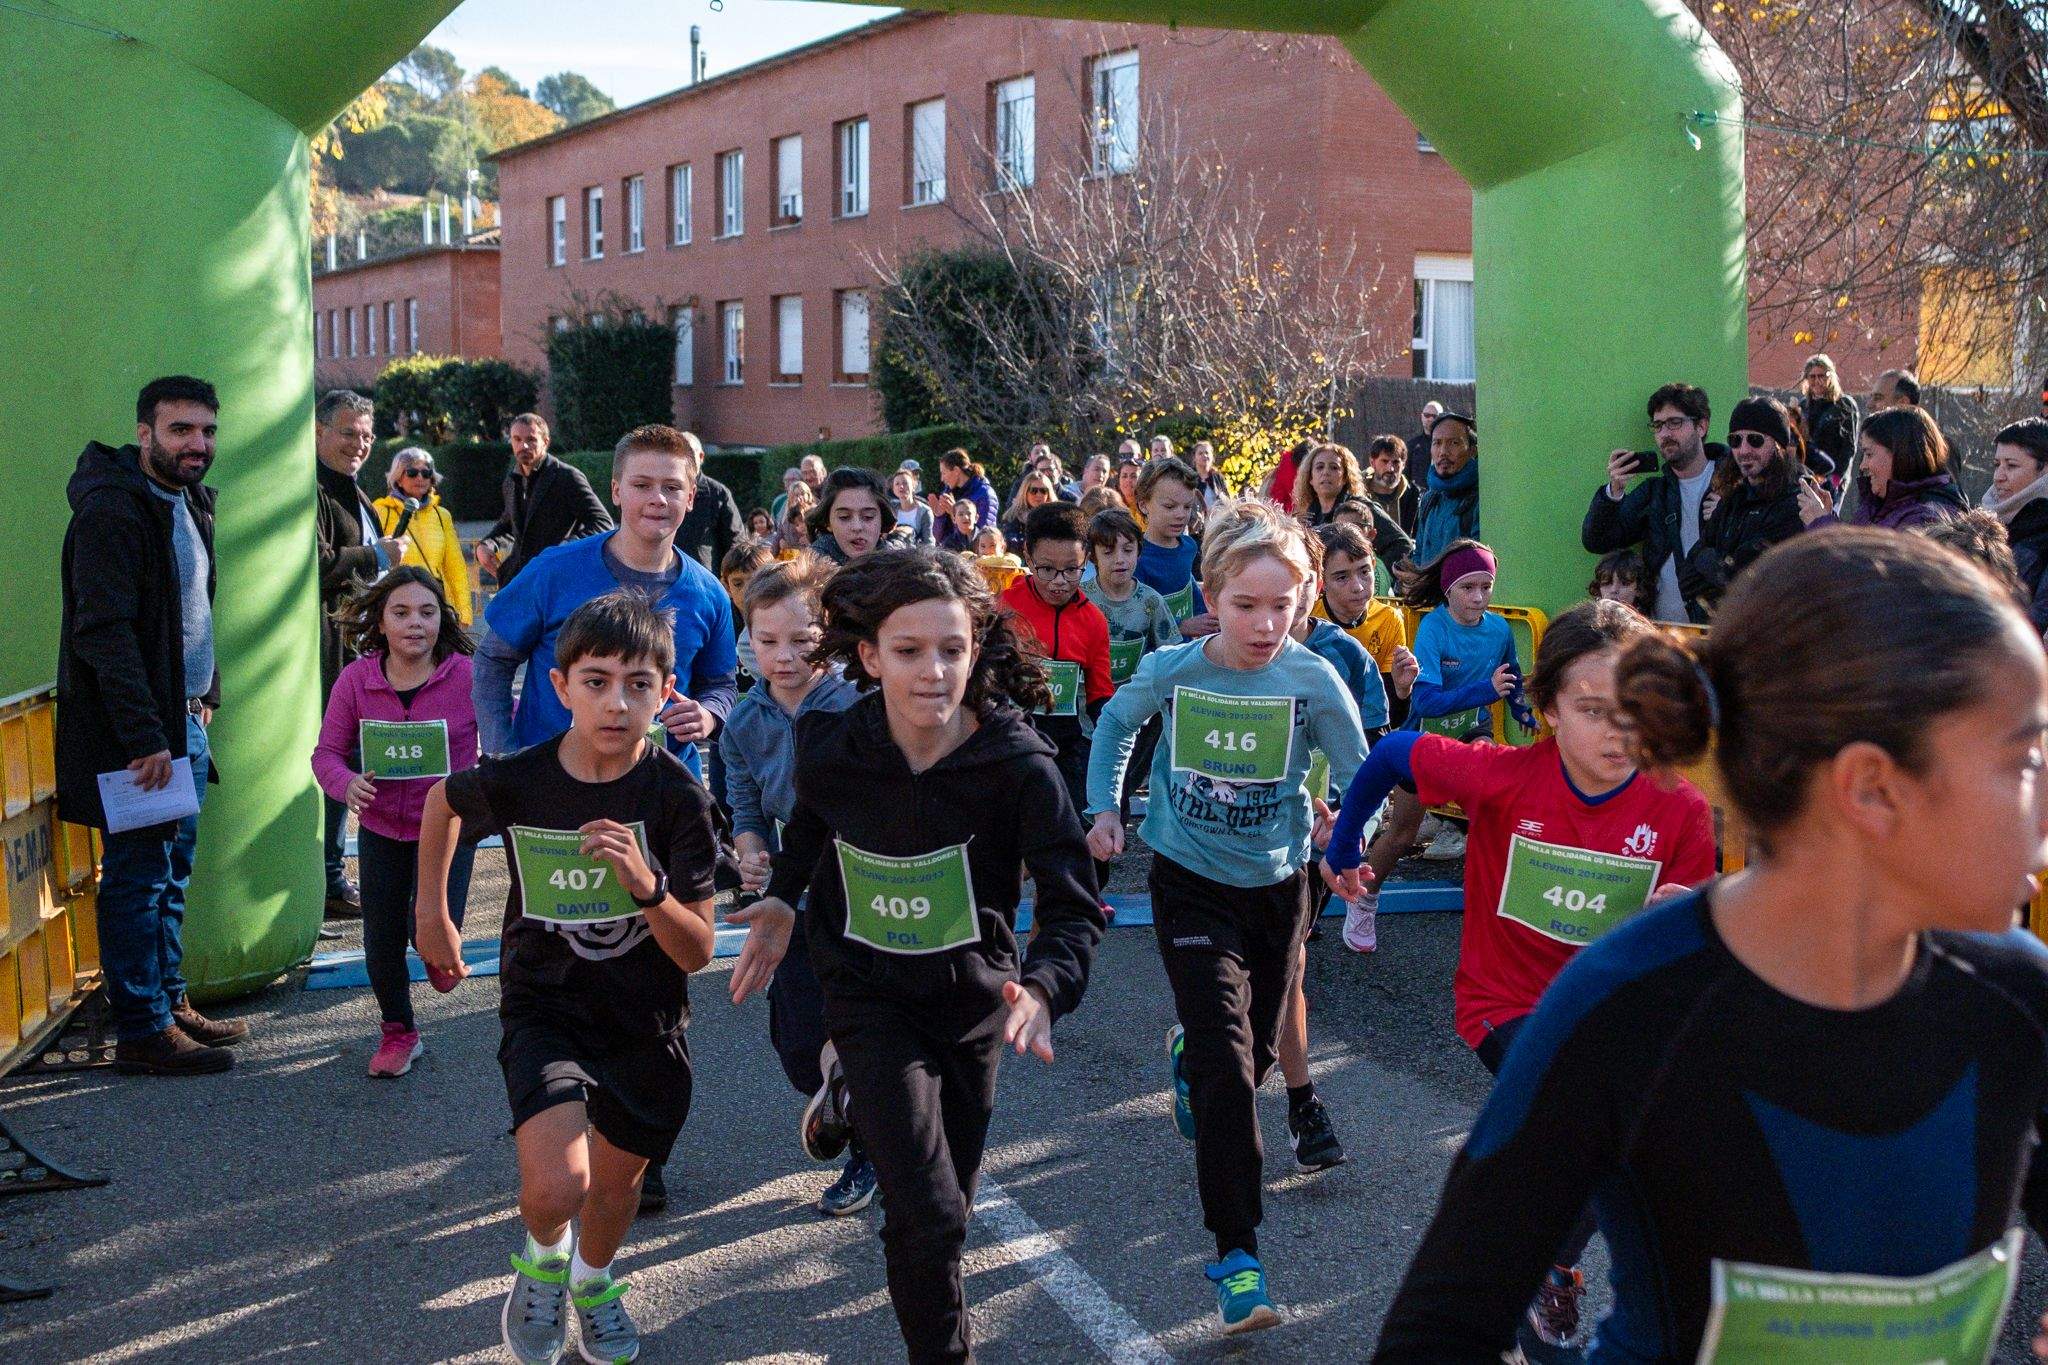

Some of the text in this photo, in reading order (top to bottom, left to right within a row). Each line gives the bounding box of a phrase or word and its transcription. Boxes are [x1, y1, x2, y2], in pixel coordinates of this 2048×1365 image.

[1111, 657, 1127, 668] 15
[1188, 692, 1206, 701] MILLA
[1190, 706, 1226, 719] ALEVINS
[1205, 730, 1257, 752] 416
[385, 745, 423, 759] 418
[1203, 759, 1256, 774] BRUNO
[914, 850, 959, 868] VALLDOREIX
[1527, 844, 1550, 854] MILLA
[1594, 856, 1604, 864] DE
[549, 868, 607, 891] 407
[1529, 858, 1631, 883] ALEVINS 2012-2013
[556, 902, 610, 915] DAVID
[871, 894, 931, 919] 409
[1542, 885, 1607, 914] 404
[1550, 919, 1588, 937] ROC
[886, 931, 922, 944] POL
